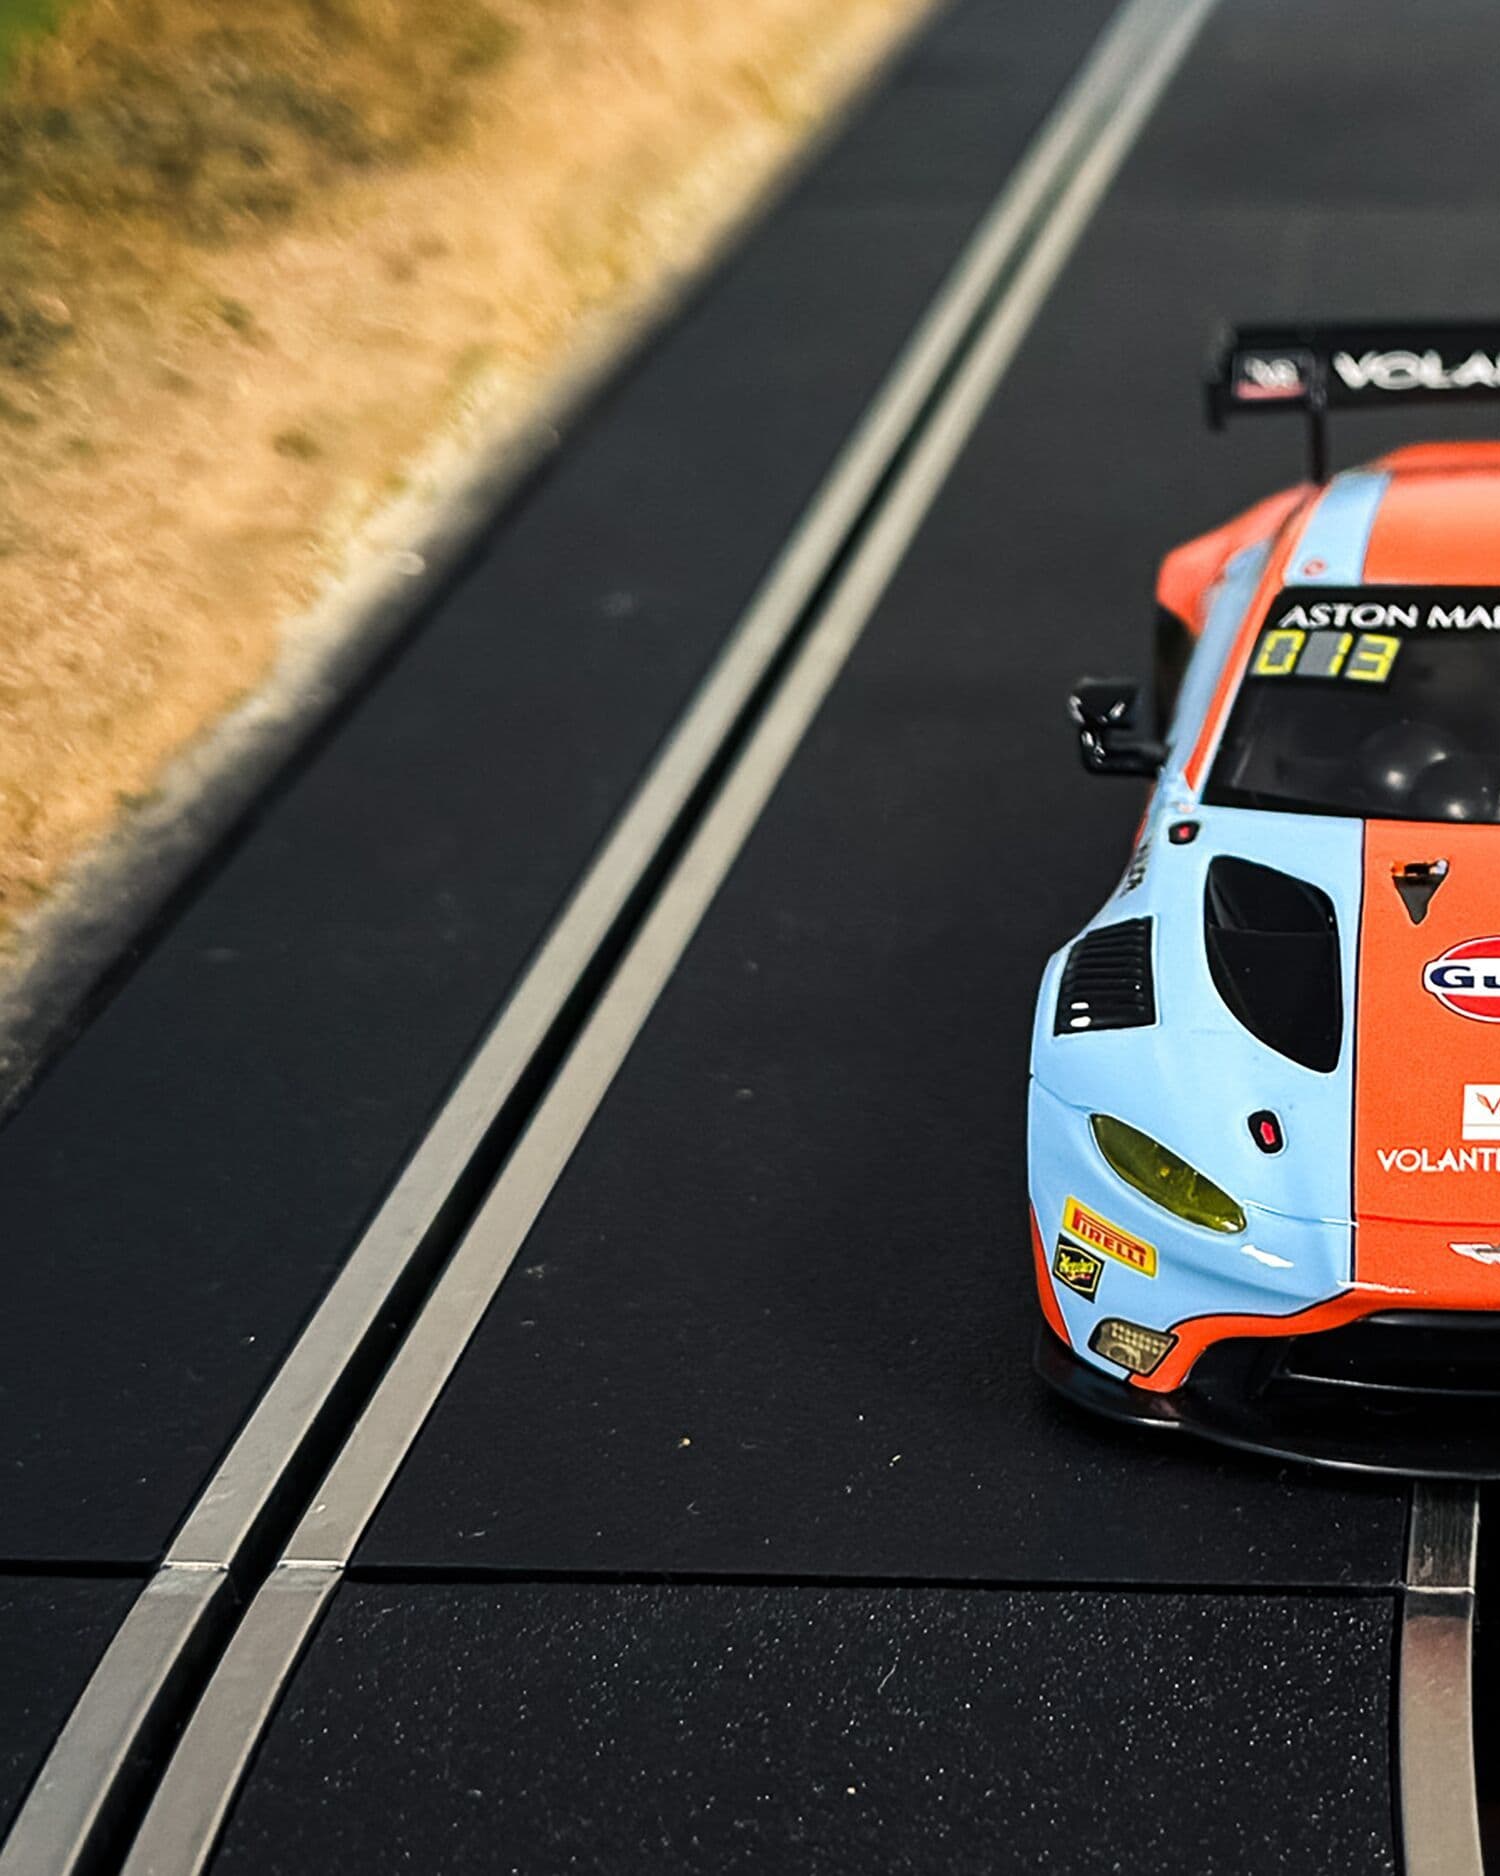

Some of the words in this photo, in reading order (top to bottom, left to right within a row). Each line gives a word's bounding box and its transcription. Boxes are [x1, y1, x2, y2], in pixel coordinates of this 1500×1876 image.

[1278, 602, 1419, 630] ASTON
[1252, 630, 1401, 682] 013
[1071, 1207, 1148, 1268] PIRELLI
